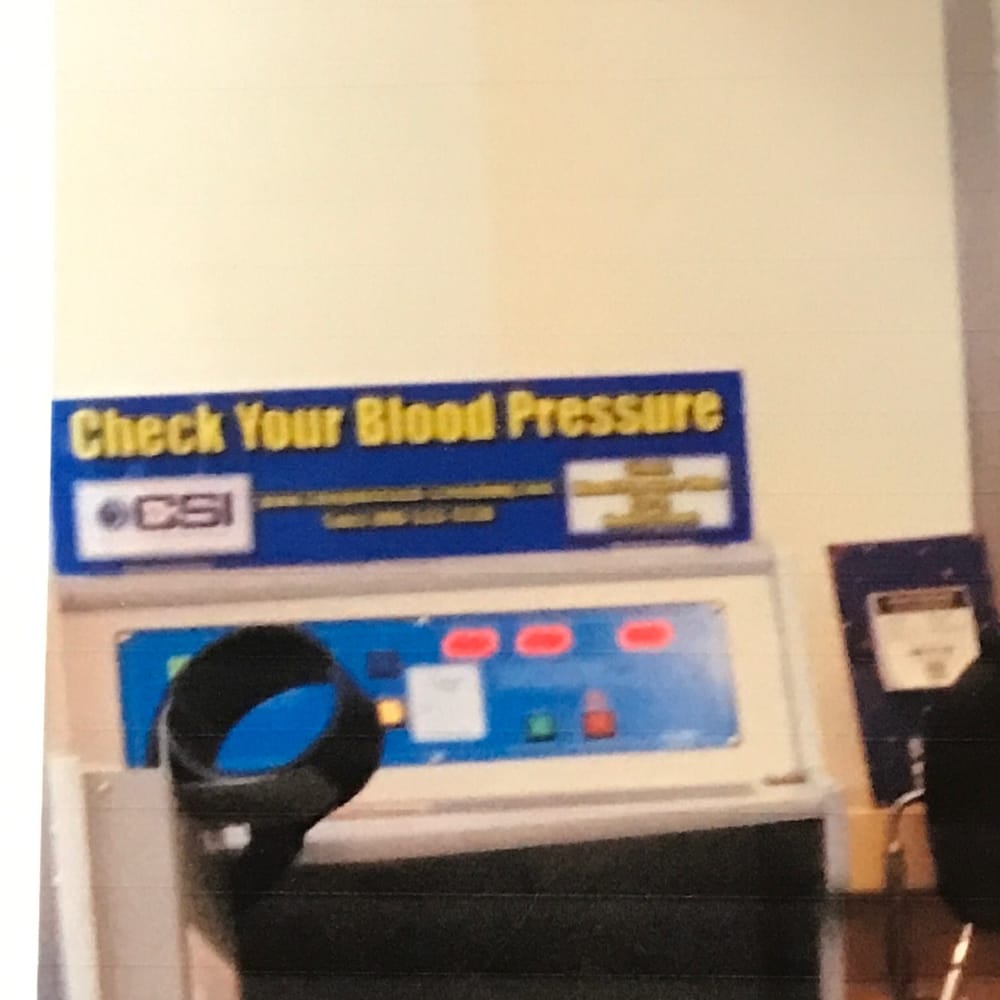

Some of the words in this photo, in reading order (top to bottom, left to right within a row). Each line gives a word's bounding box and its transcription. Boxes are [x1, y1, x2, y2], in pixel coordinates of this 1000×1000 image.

[69, 403, 226, 461] Check
[233, 401, 345, 451] Your
[355, 391, 497, 445] Blood
[508, 389, 724, 439] Pressure
[134, 492, 234, 530] CSI
